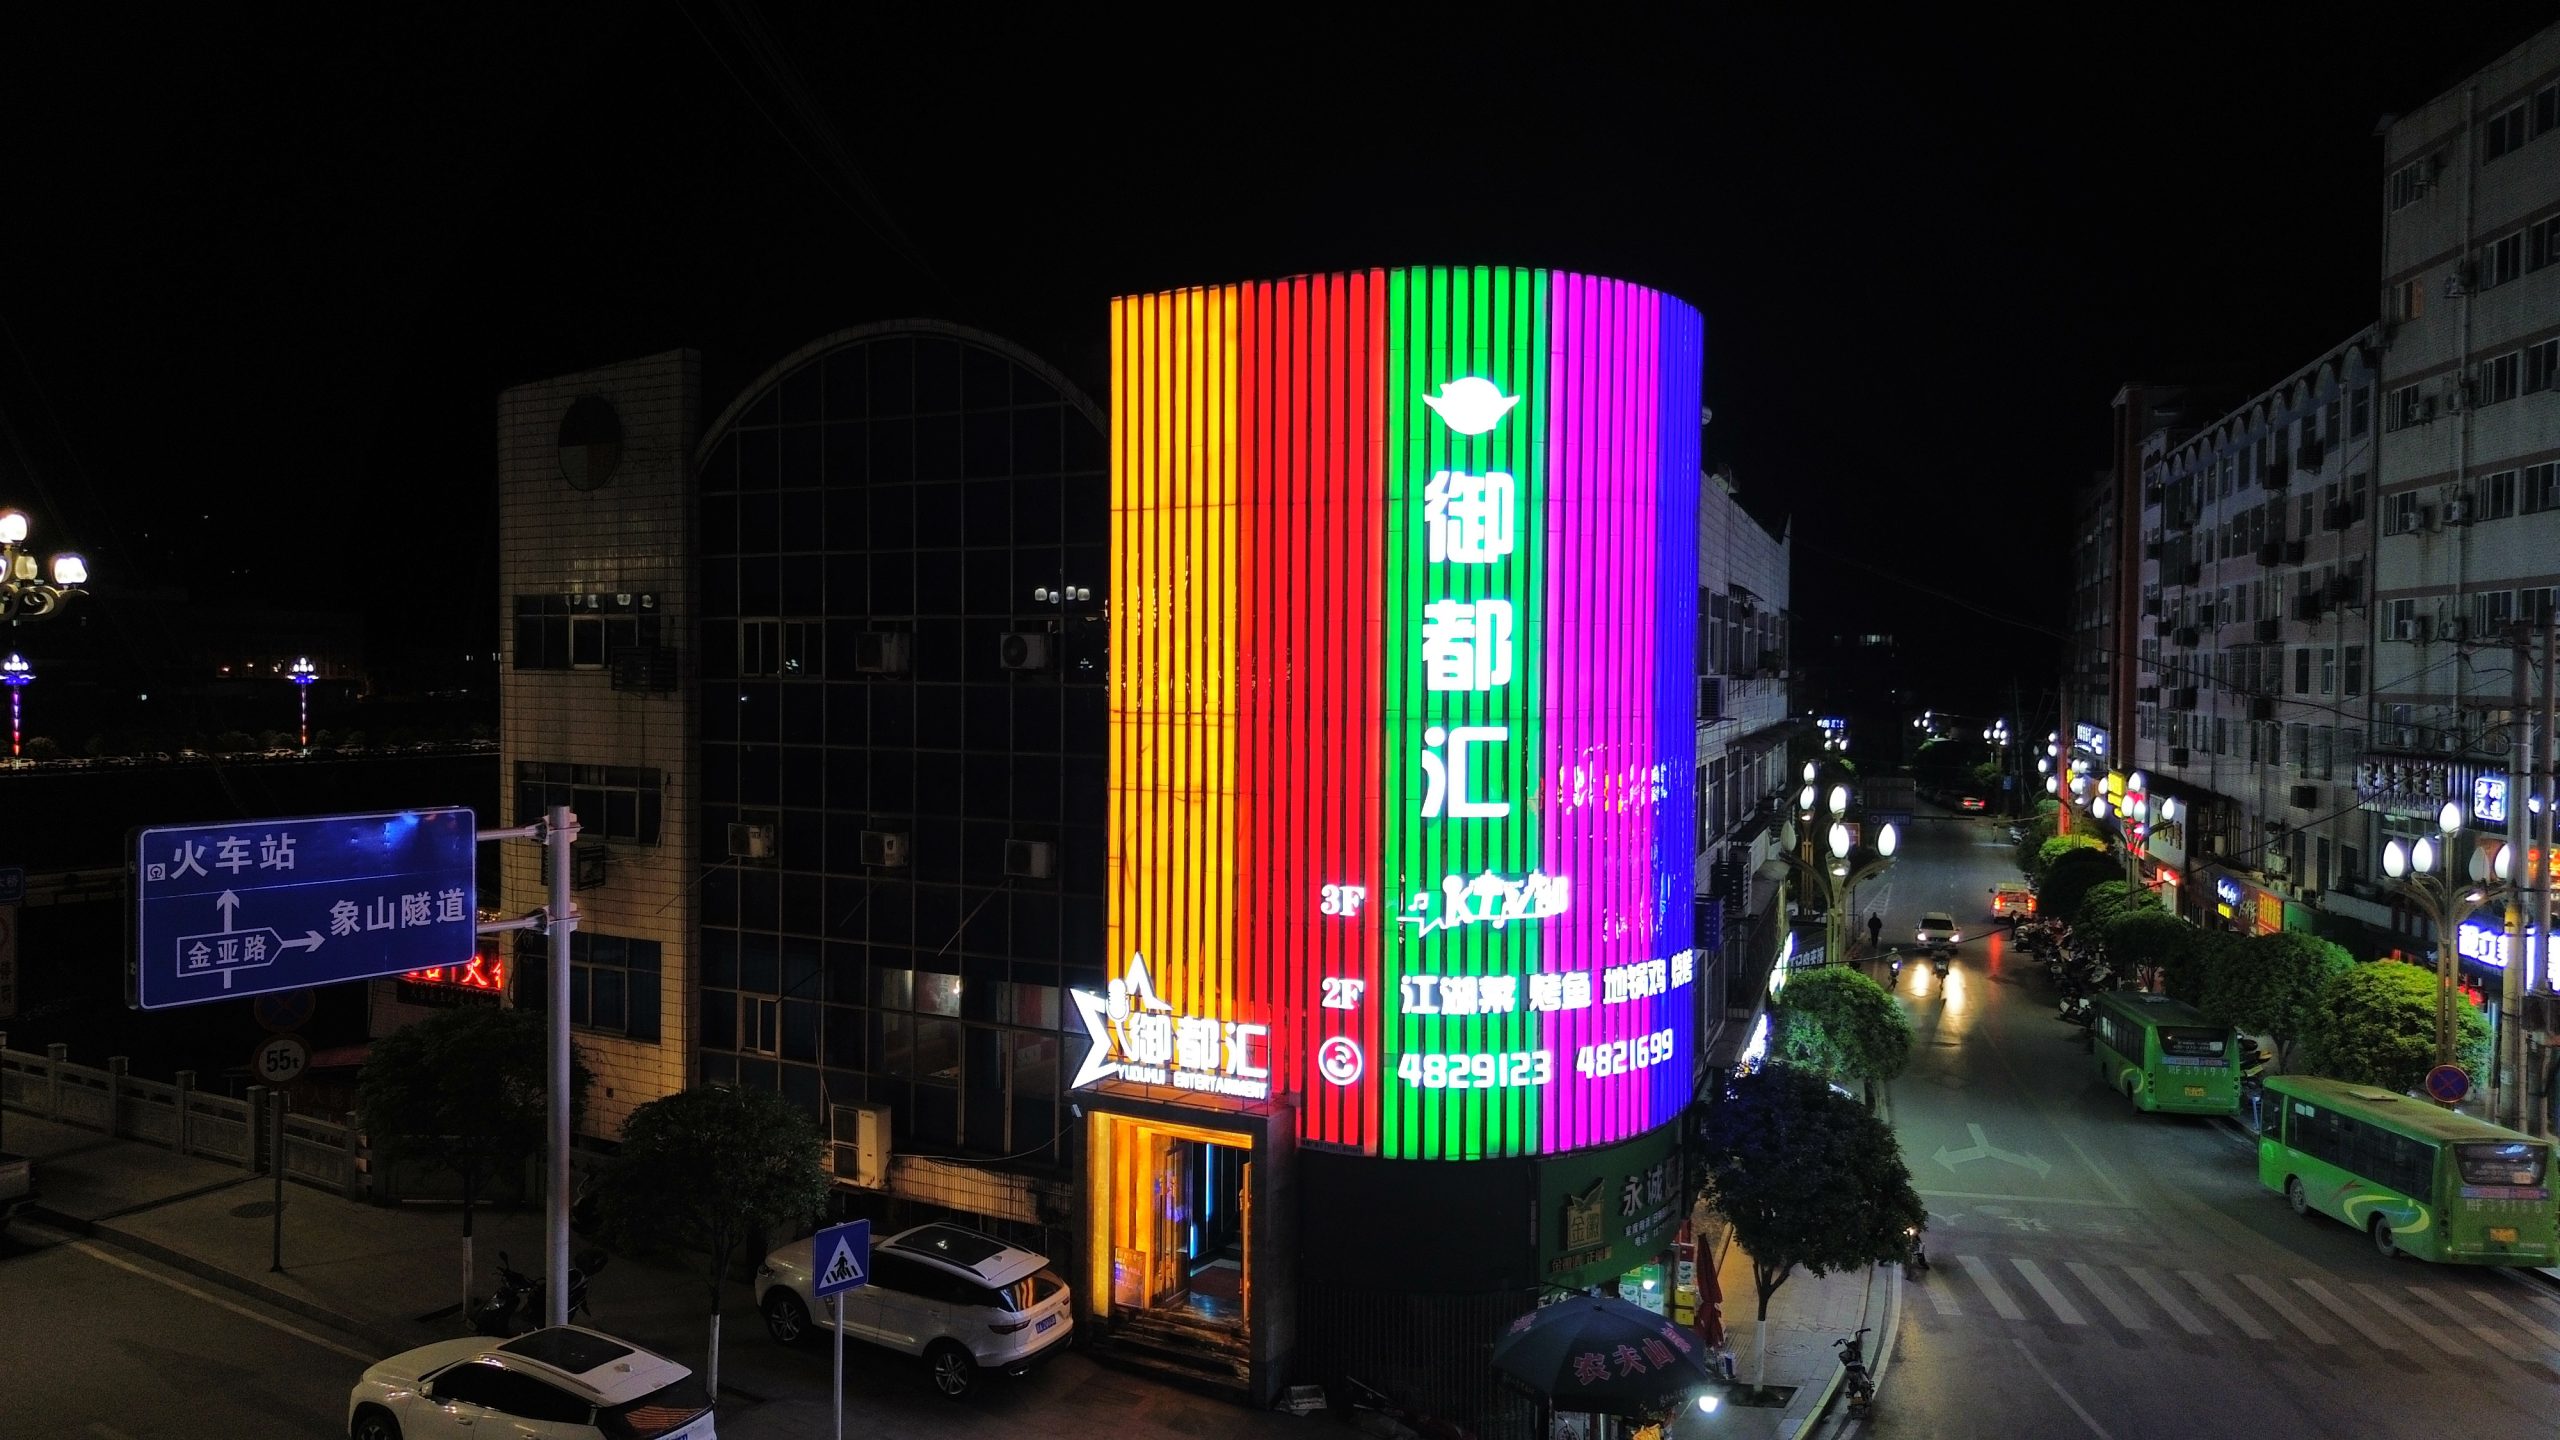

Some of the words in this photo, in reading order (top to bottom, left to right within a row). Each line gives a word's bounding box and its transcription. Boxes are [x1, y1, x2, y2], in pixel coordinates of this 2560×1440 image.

[1421, 470, 1515, 818] 御都汇
[170, 834, 297, 880] 火车站
[329, 887, 466, 937] 象山隧道
[1320, 884, 1365, 917] 3F
[188, 934, 267, 970] 金亚路
[1321, 977, 1364, 1010] 2F
[1400, 974, 1517, 1016] 江湖菜
[1529, 971, 1592, 1012] 烤鱼
[1602, 958, 1667, 1006] 地锅鸡
[266, 1048, 300, 1073] 55t
[1128, 1011, 1269, 1079] 御都汇
[1397, 1049, 1552, 1090] 4829123
[1575, 1027, 1675, 1080] 4821699
